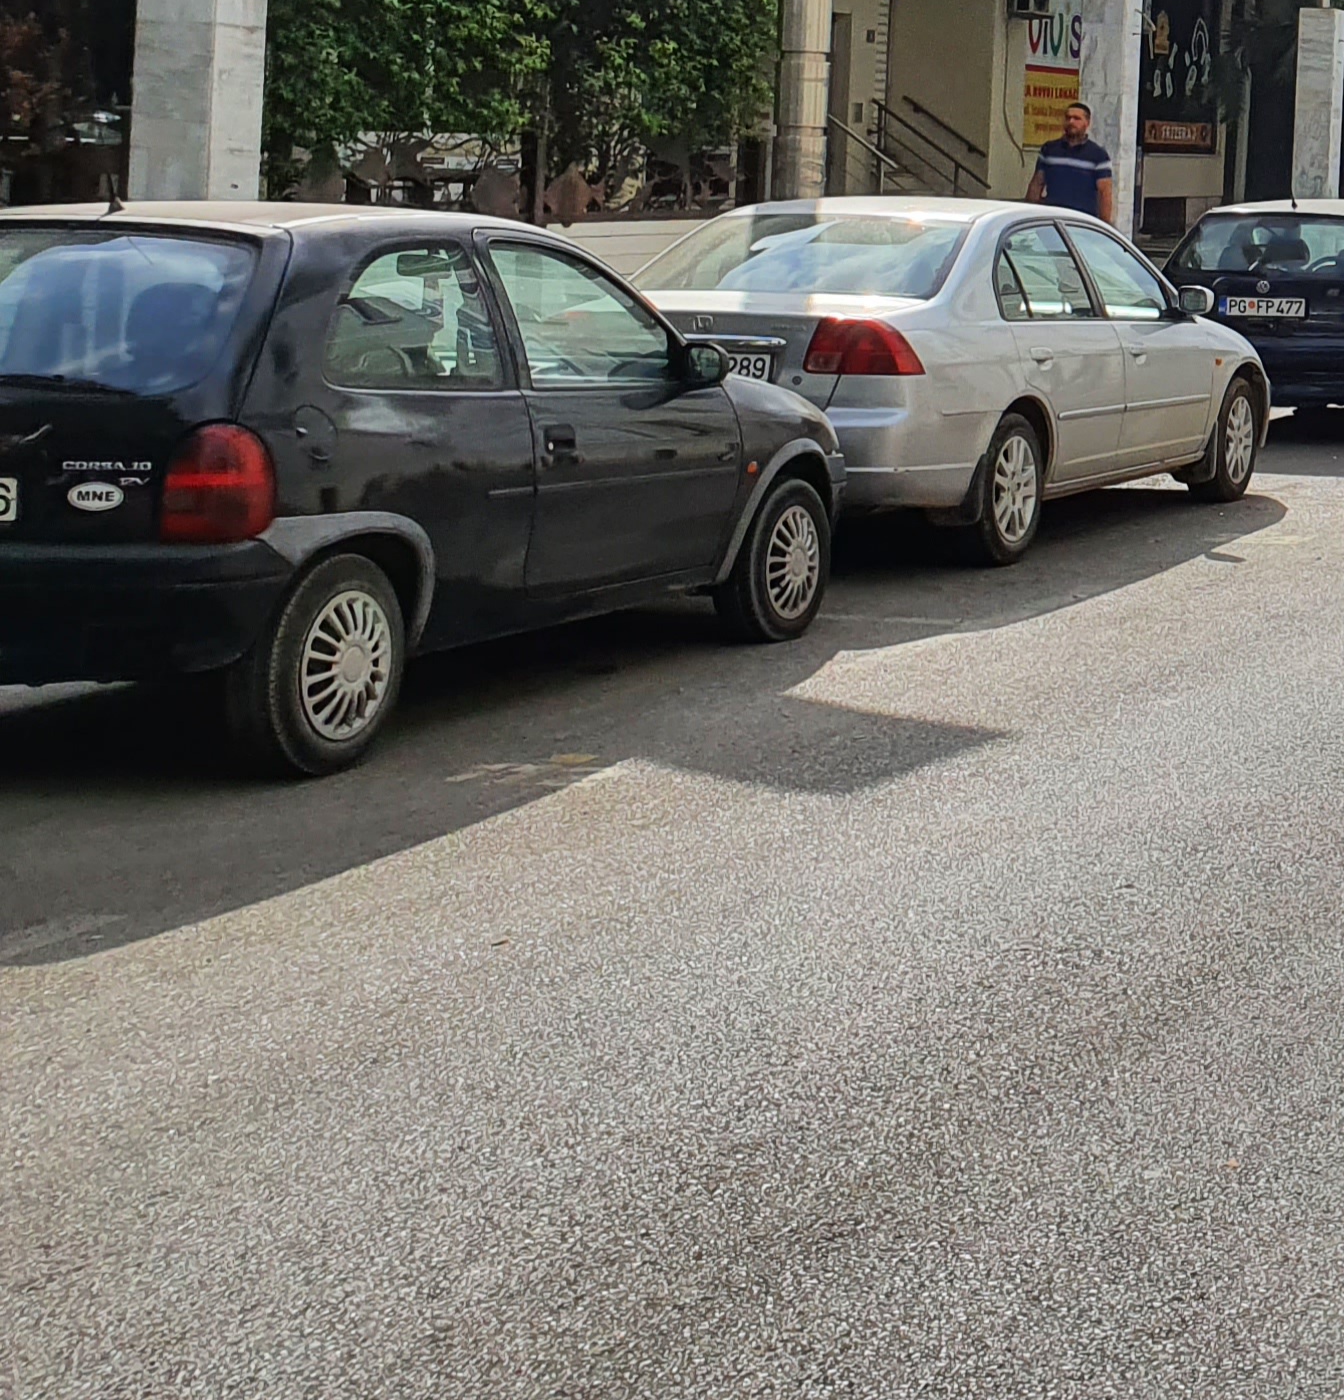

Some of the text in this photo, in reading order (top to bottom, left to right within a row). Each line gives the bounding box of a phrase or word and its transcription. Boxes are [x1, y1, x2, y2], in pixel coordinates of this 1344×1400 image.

[1228, 299, 1304, 315] PG FP 477
[62, 460, 126, 471] CORSA
[76, 490, 116, 502] MNE
